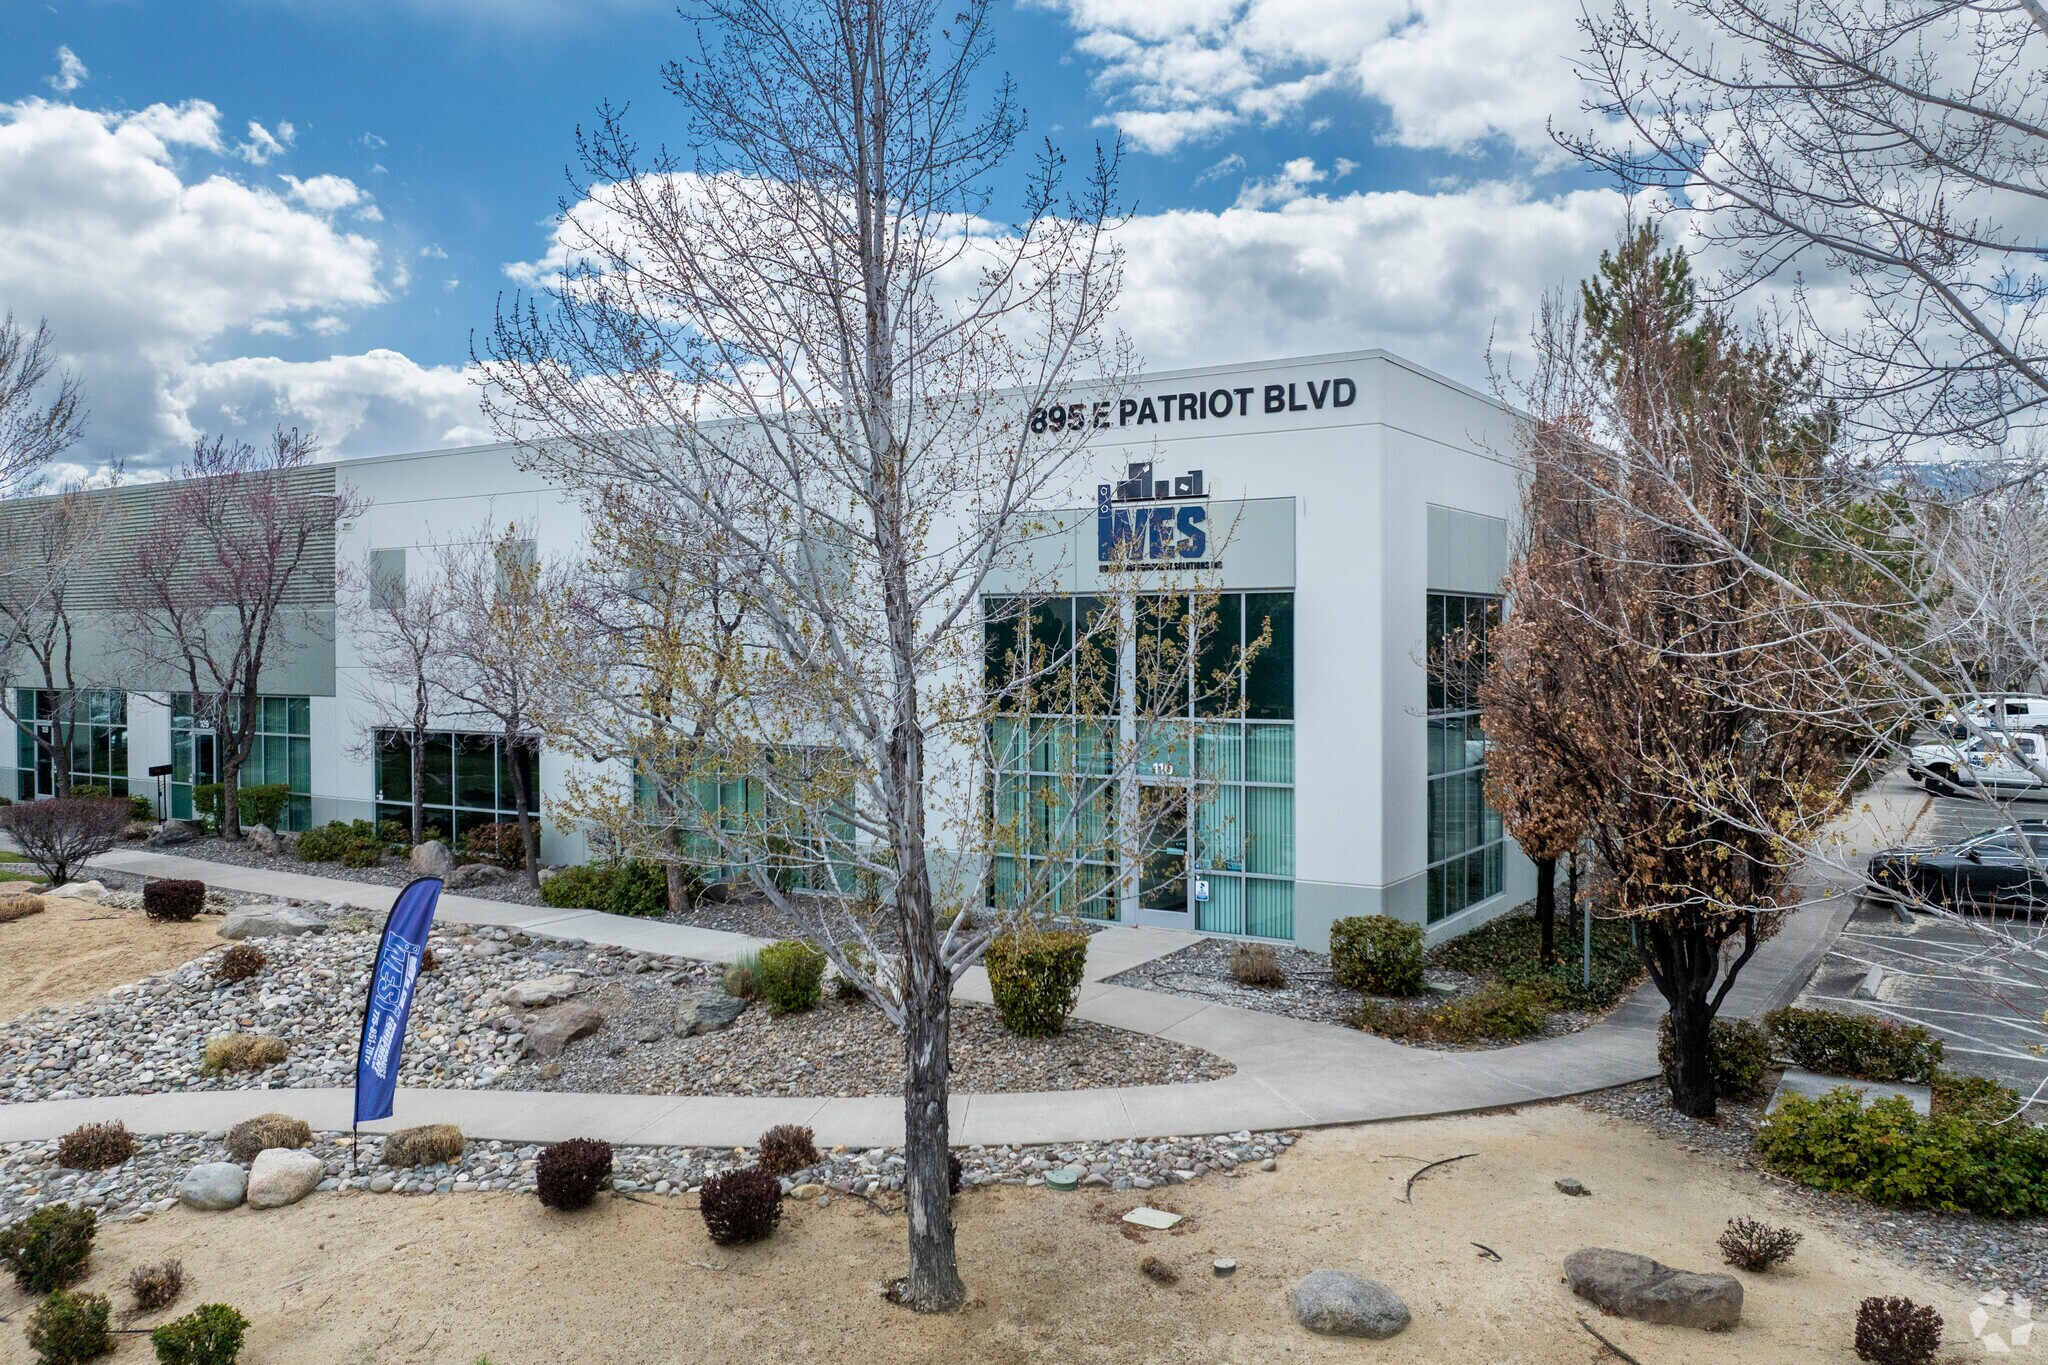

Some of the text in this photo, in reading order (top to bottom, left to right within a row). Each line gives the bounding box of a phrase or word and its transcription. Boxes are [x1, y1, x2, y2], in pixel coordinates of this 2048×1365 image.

[1030, 377, 1357, 434] 895 E PATRIOT BLVD
[1152, 762, 1174, 775] 110
